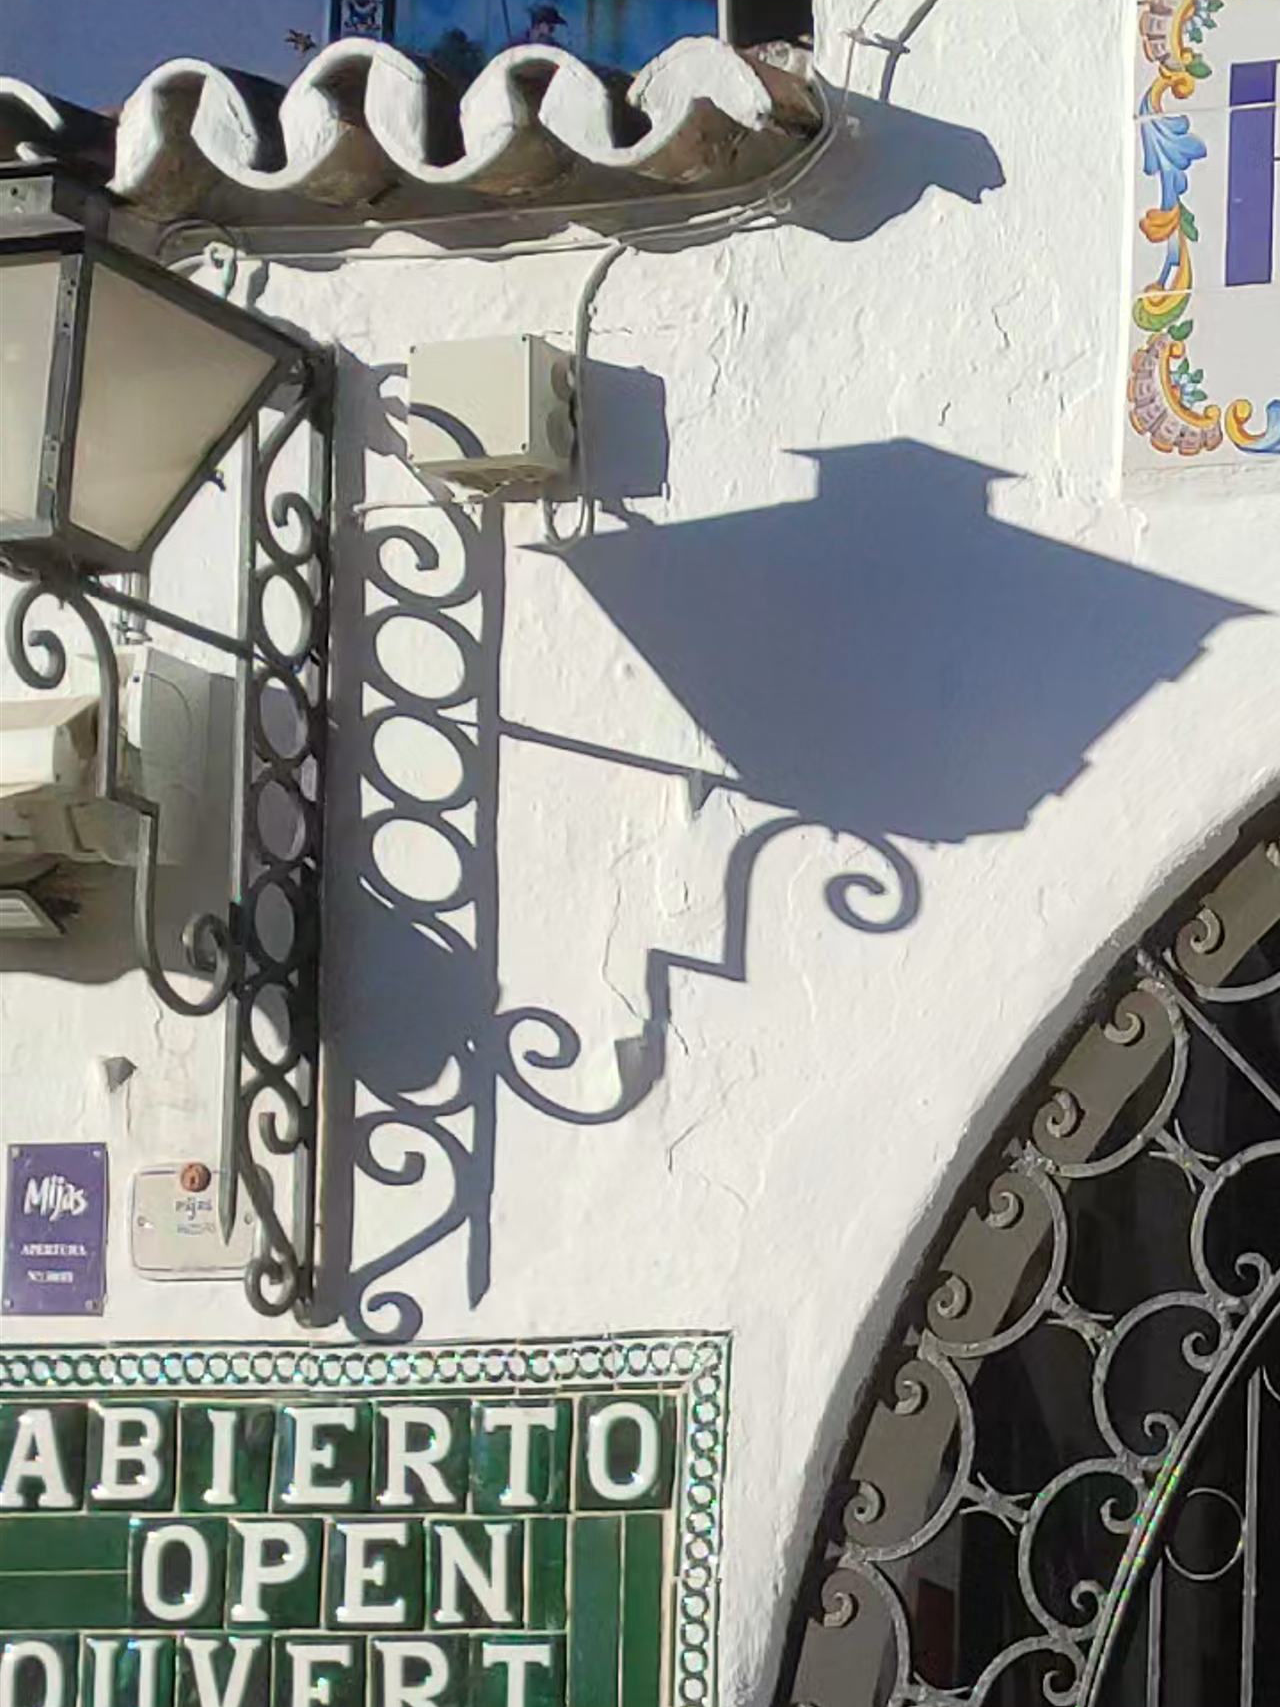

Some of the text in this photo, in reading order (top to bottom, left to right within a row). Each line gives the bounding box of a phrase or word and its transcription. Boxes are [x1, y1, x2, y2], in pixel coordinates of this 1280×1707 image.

[24, 1174, 88, 1222] Mijas
[0, 1403, 658, 1509] ABIERTO
[142, 1521, 523, 1624] OPEN
